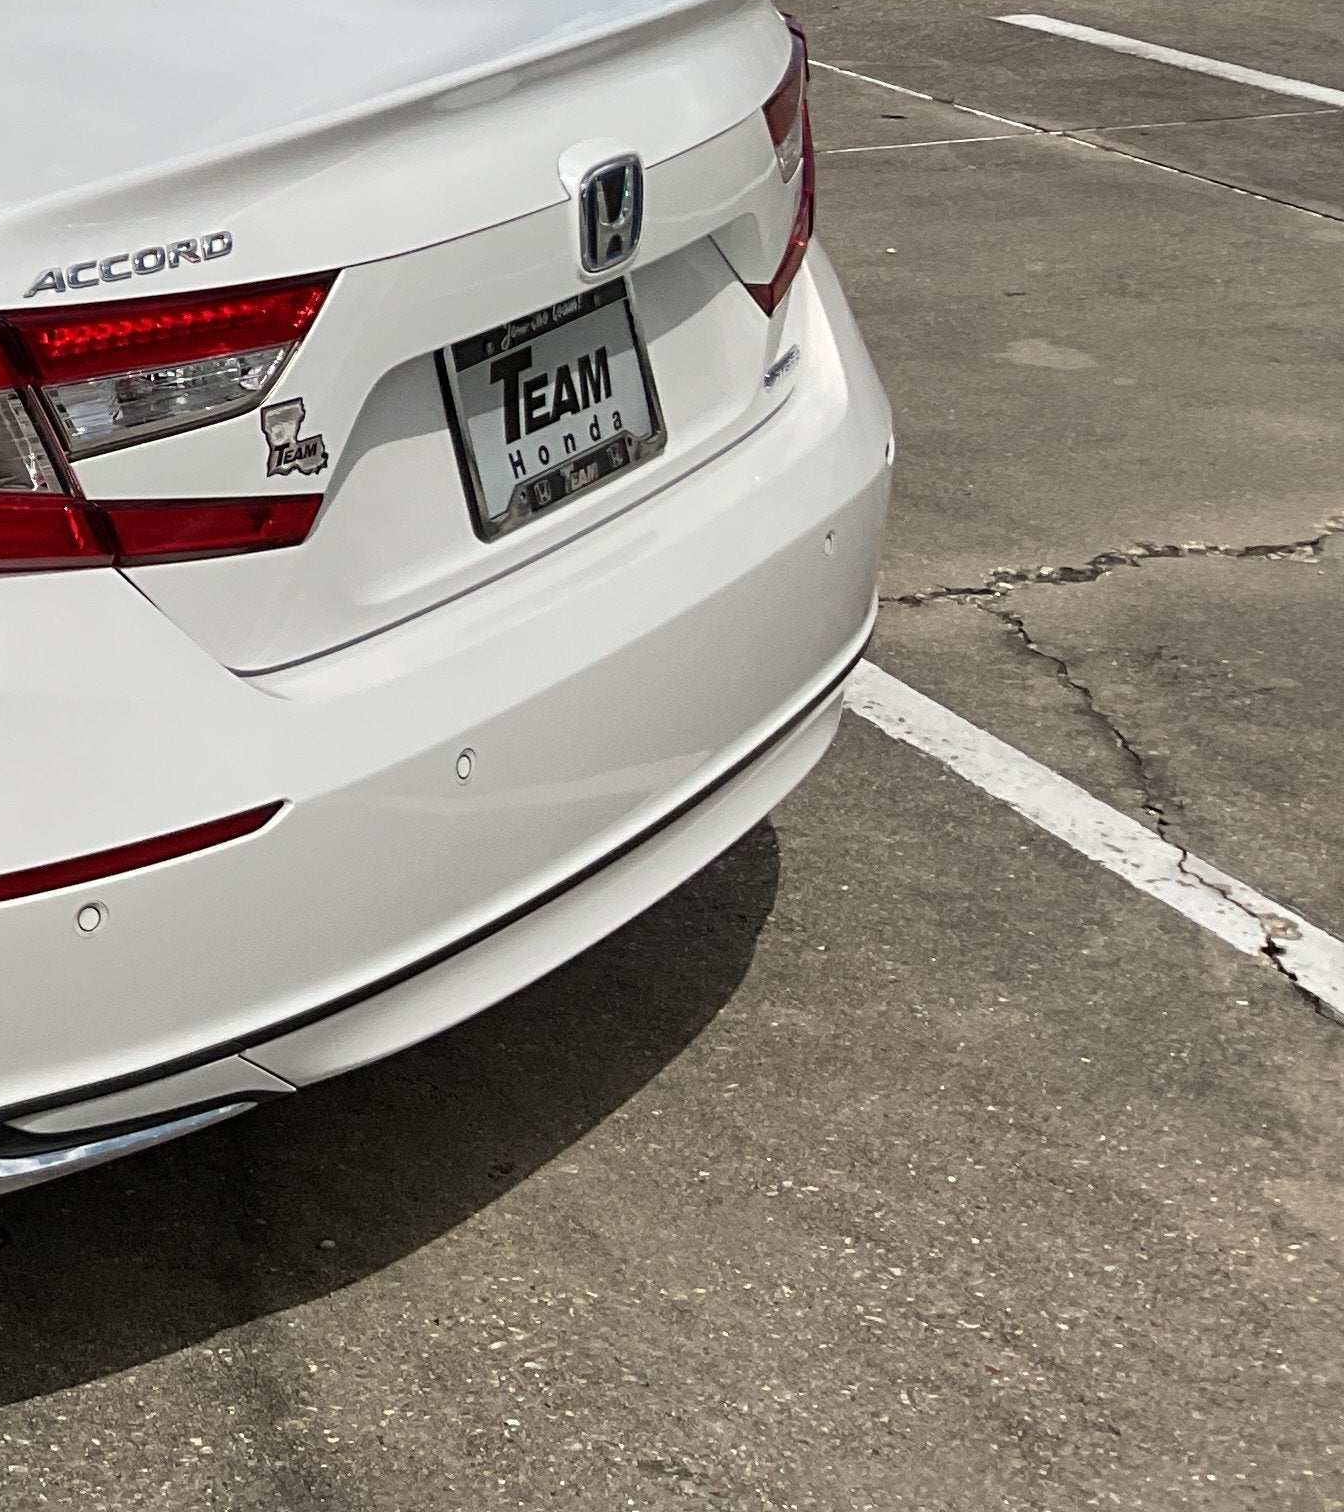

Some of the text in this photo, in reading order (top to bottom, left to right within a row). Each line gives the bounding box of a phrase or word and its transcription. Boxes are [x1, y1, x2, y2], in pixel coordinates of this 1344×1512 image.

[23, 230, 233, 298] ACCORD
[489, 345, 613, 445] TEAM
[274, 443, 318, 468] TEAM
[507, 409, 624, 480] Honda
[560, 461, 599, 494] TEAM
